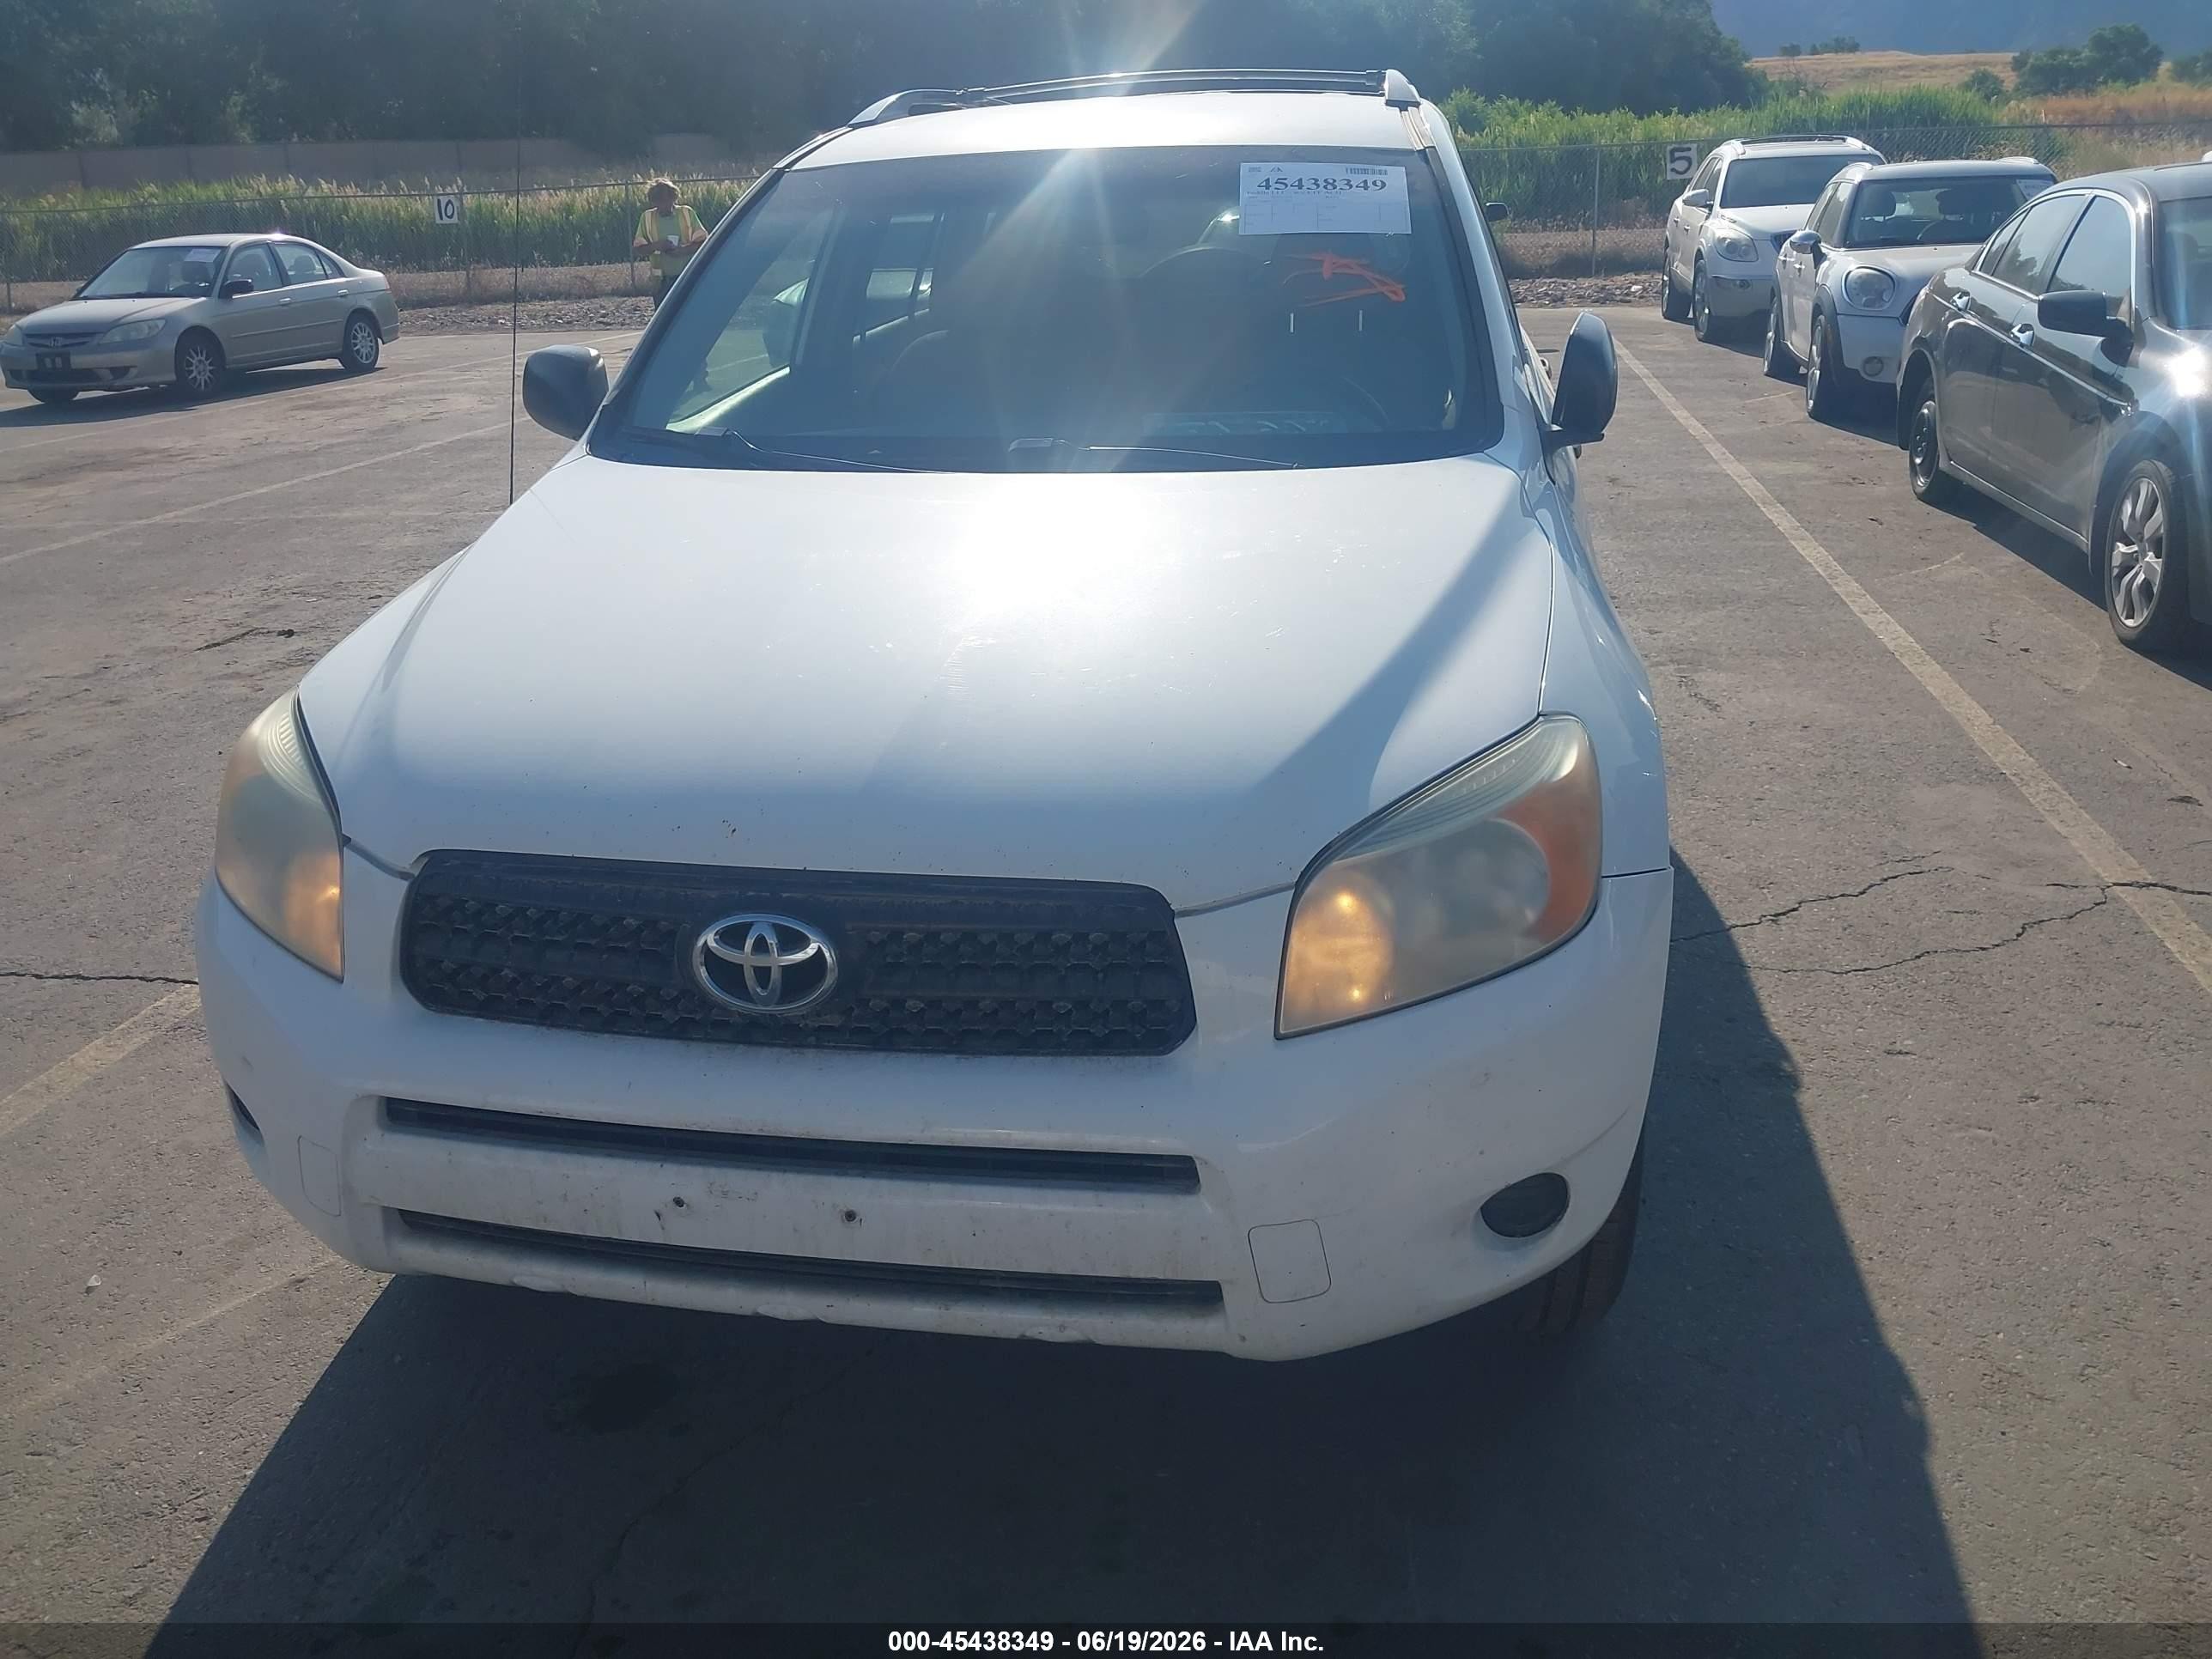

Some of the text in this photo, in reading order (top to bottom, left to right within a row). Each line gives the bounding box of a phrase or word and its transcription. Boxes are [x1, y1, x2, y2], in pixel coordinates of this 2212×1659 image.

[1669, 146, 1693, 175] 5
[1256, 177, 1388, 191] 45438349
[437, 198, 455, 221] 10
